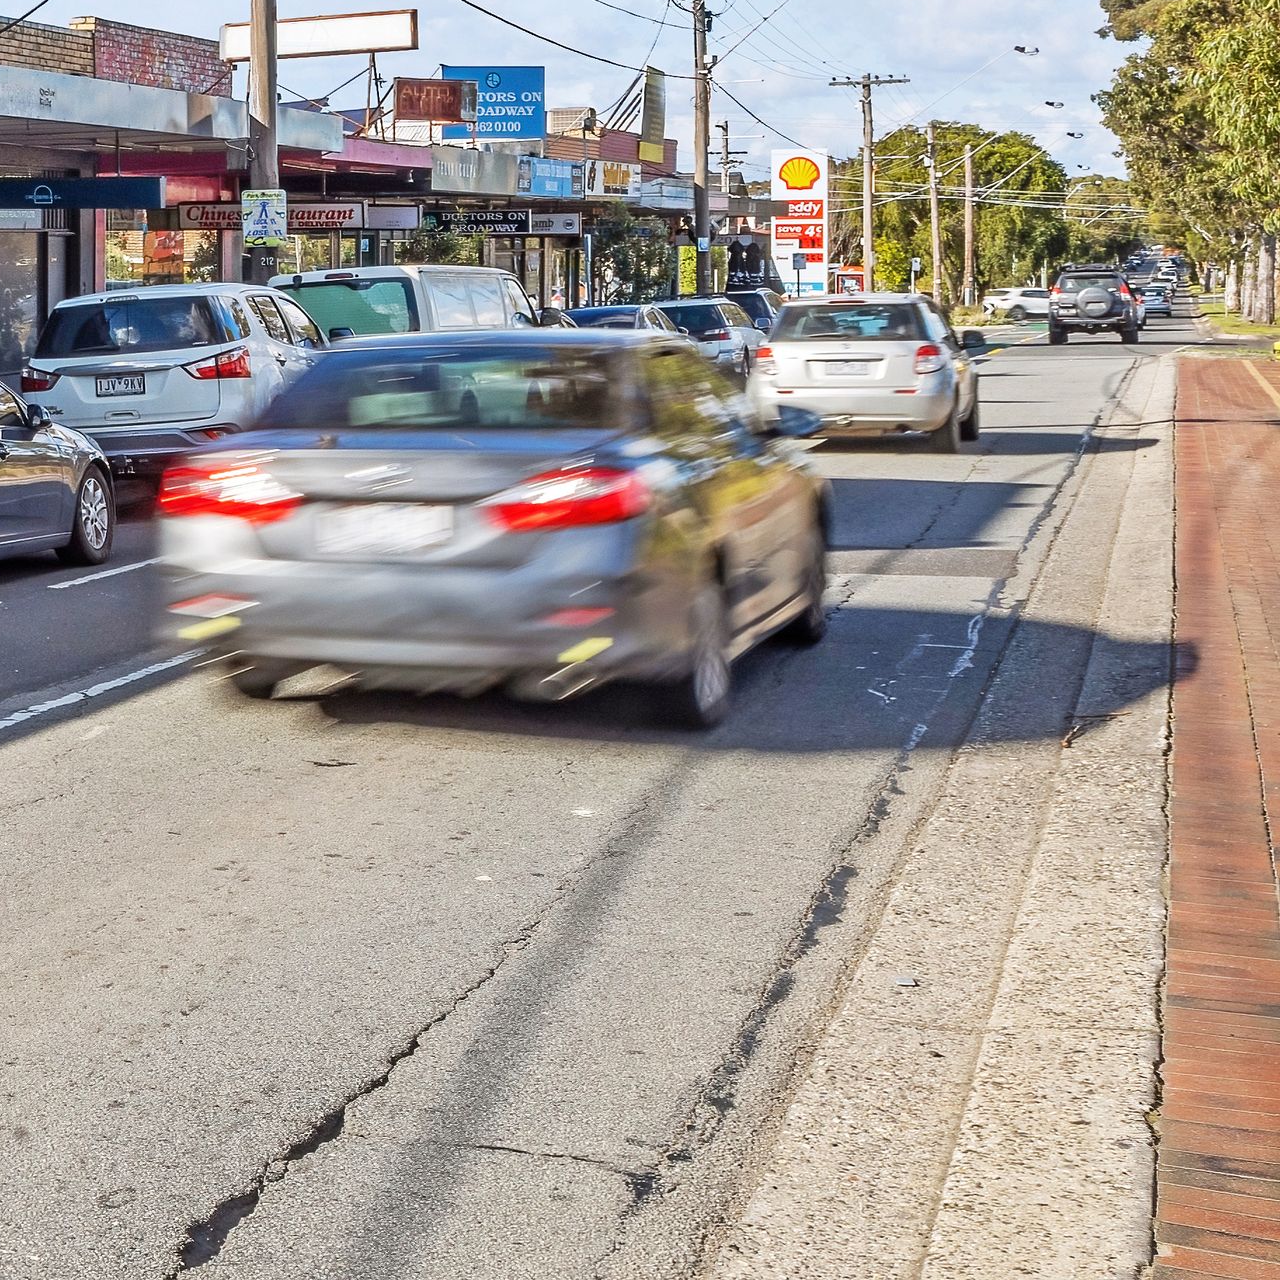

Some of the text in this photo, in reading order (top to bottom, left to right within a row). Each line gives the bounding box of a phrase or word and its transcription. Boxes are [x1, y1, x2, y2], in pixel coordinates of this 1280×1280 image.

[477, 92, 542, 102] TORS ON
[477, 106, 535, 116] OADWAY
[495, 122, 521, 132] 0100
[187, 205, 356, 221] Chines taurant
[788, 201, 822, 216] eddy
[508, 212, 526, 221] ON
[777, 225, 802, 233] save
[260, 257, 274, 265] 212
